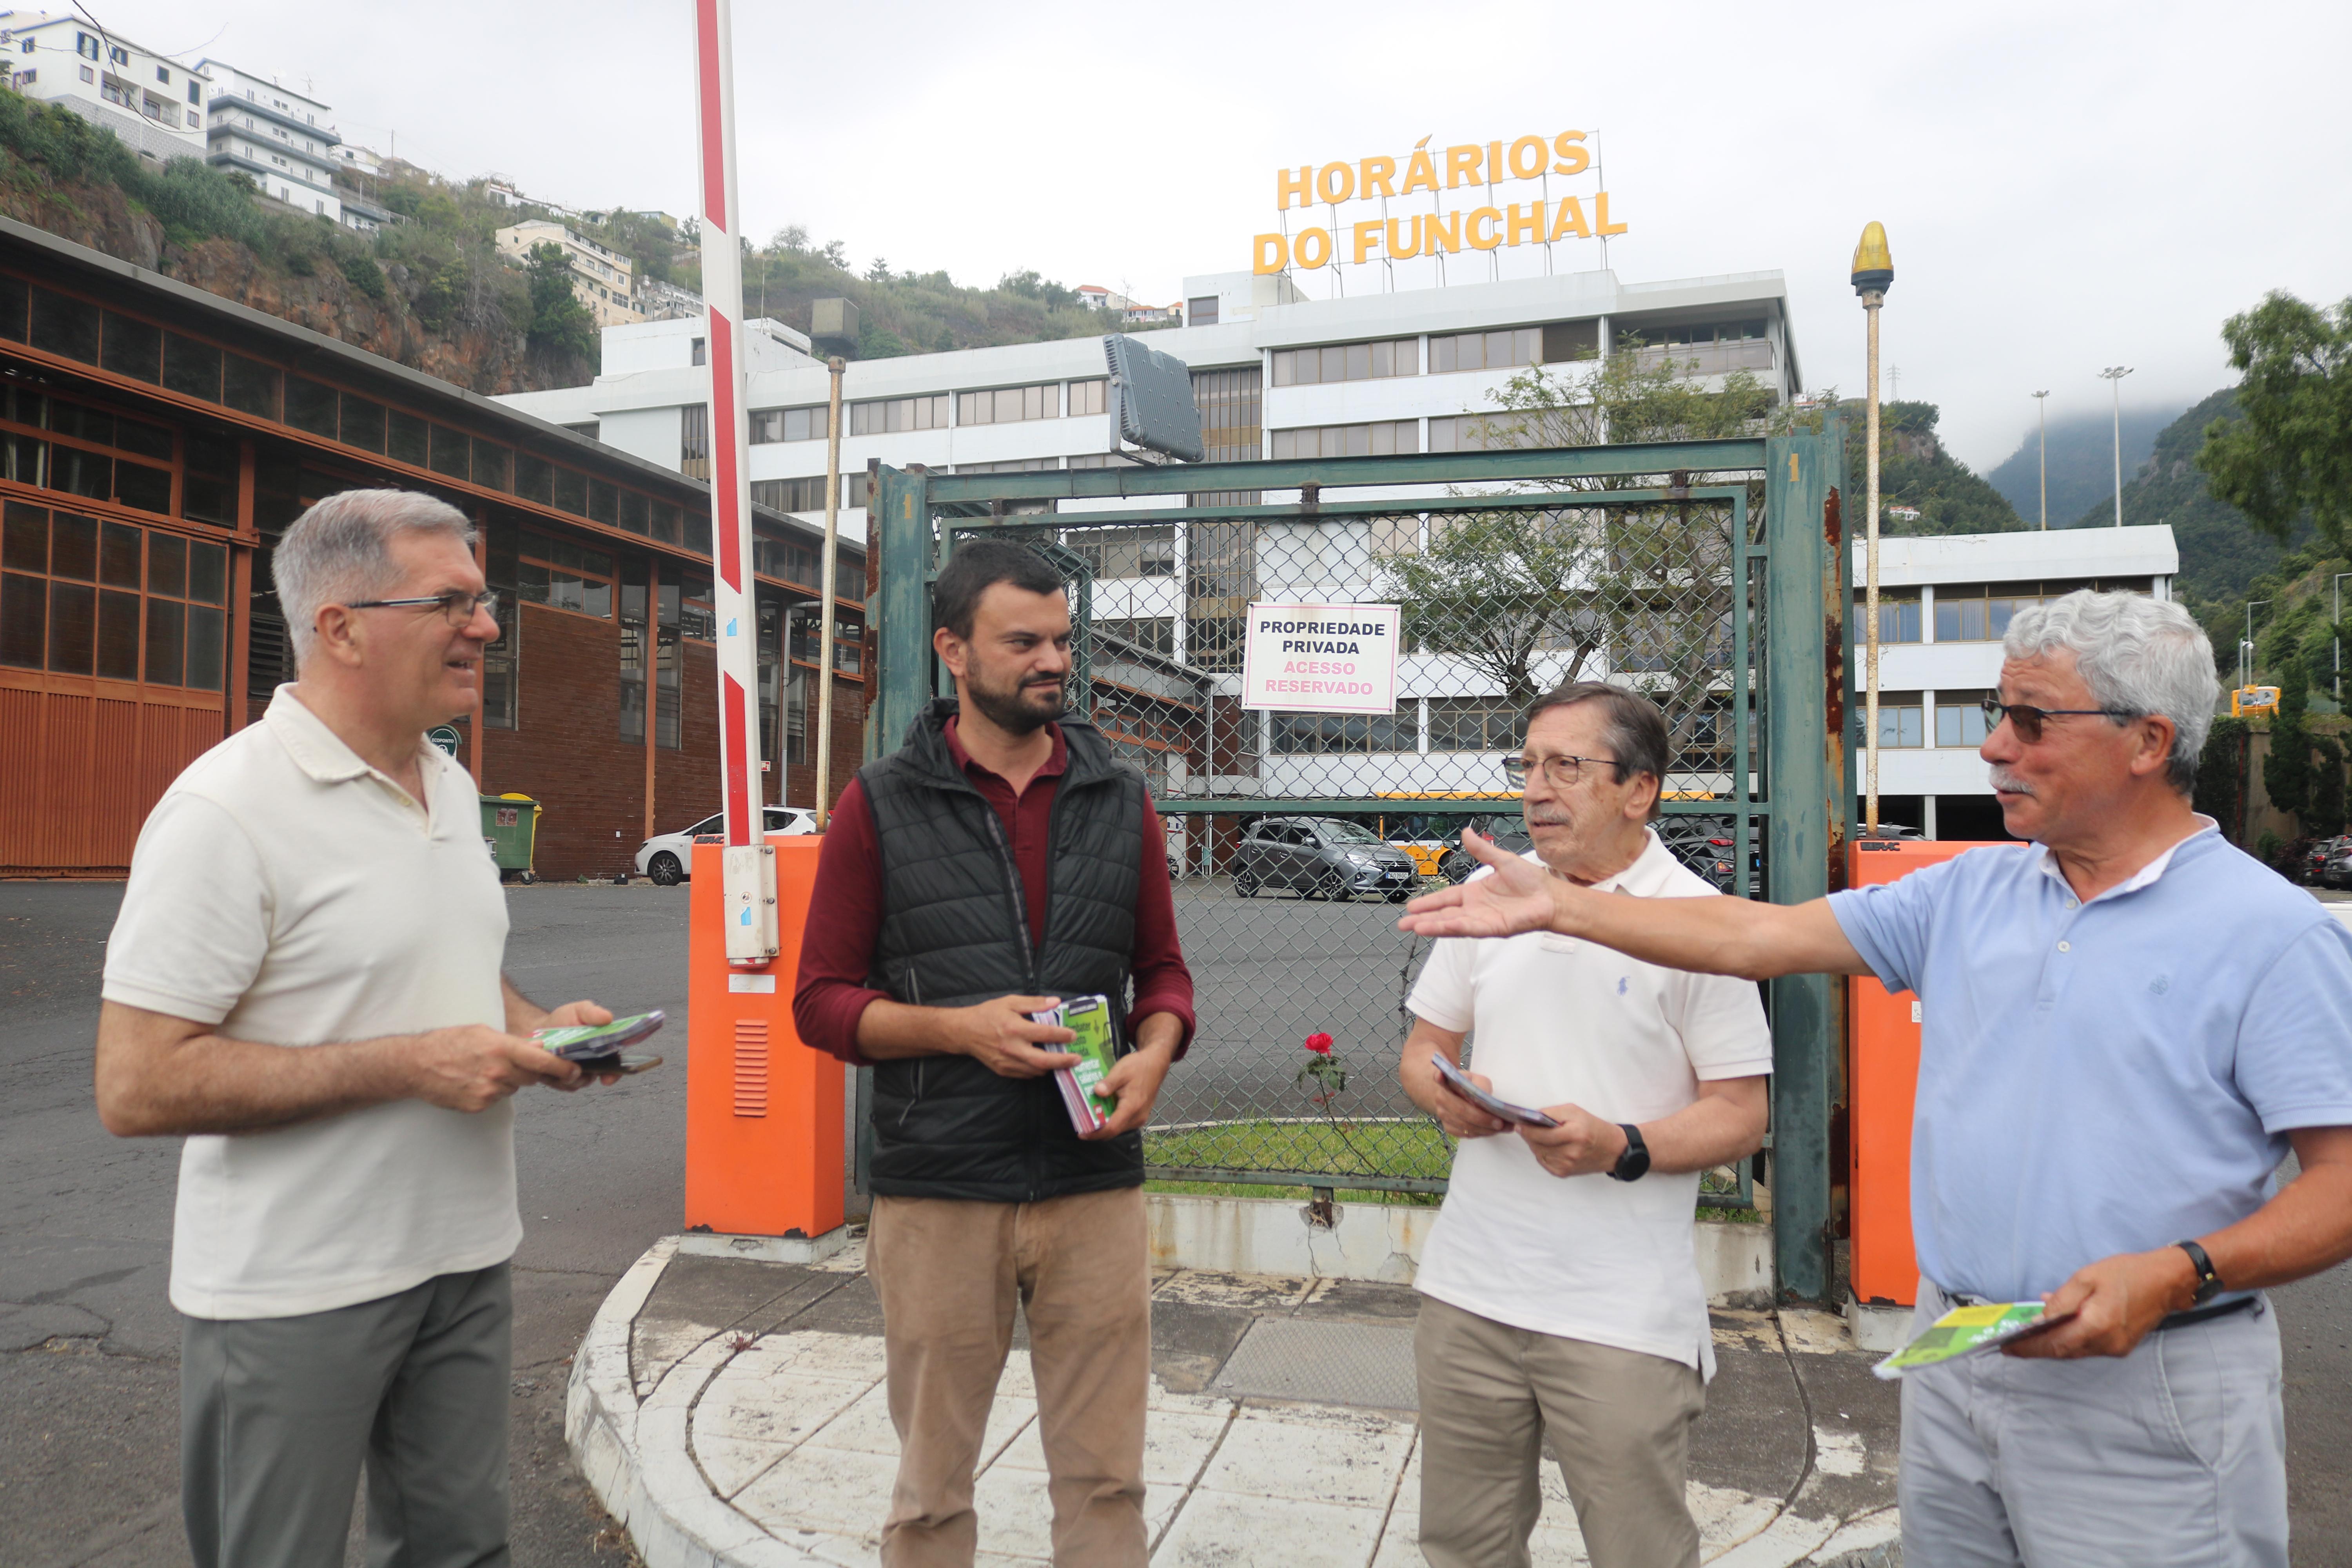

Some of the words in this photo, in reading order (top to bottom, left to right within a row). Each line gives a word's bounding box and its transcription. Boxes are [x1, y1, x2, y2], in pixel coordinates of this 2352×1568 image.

[1278, 130, 1590, 210] HORÁRIOS
[1253, 227, 1332, 276] DO
[1354, 192, 1628, 264] FUNCHAL
[1260, 621, 1385, 636] PROPRIEDADE
[1283, 640, 1359, 654] PRIVADA
[1284, 661, 1356, 675] ACESSO
[1266, 679, 1373, 695] RESERVADO
